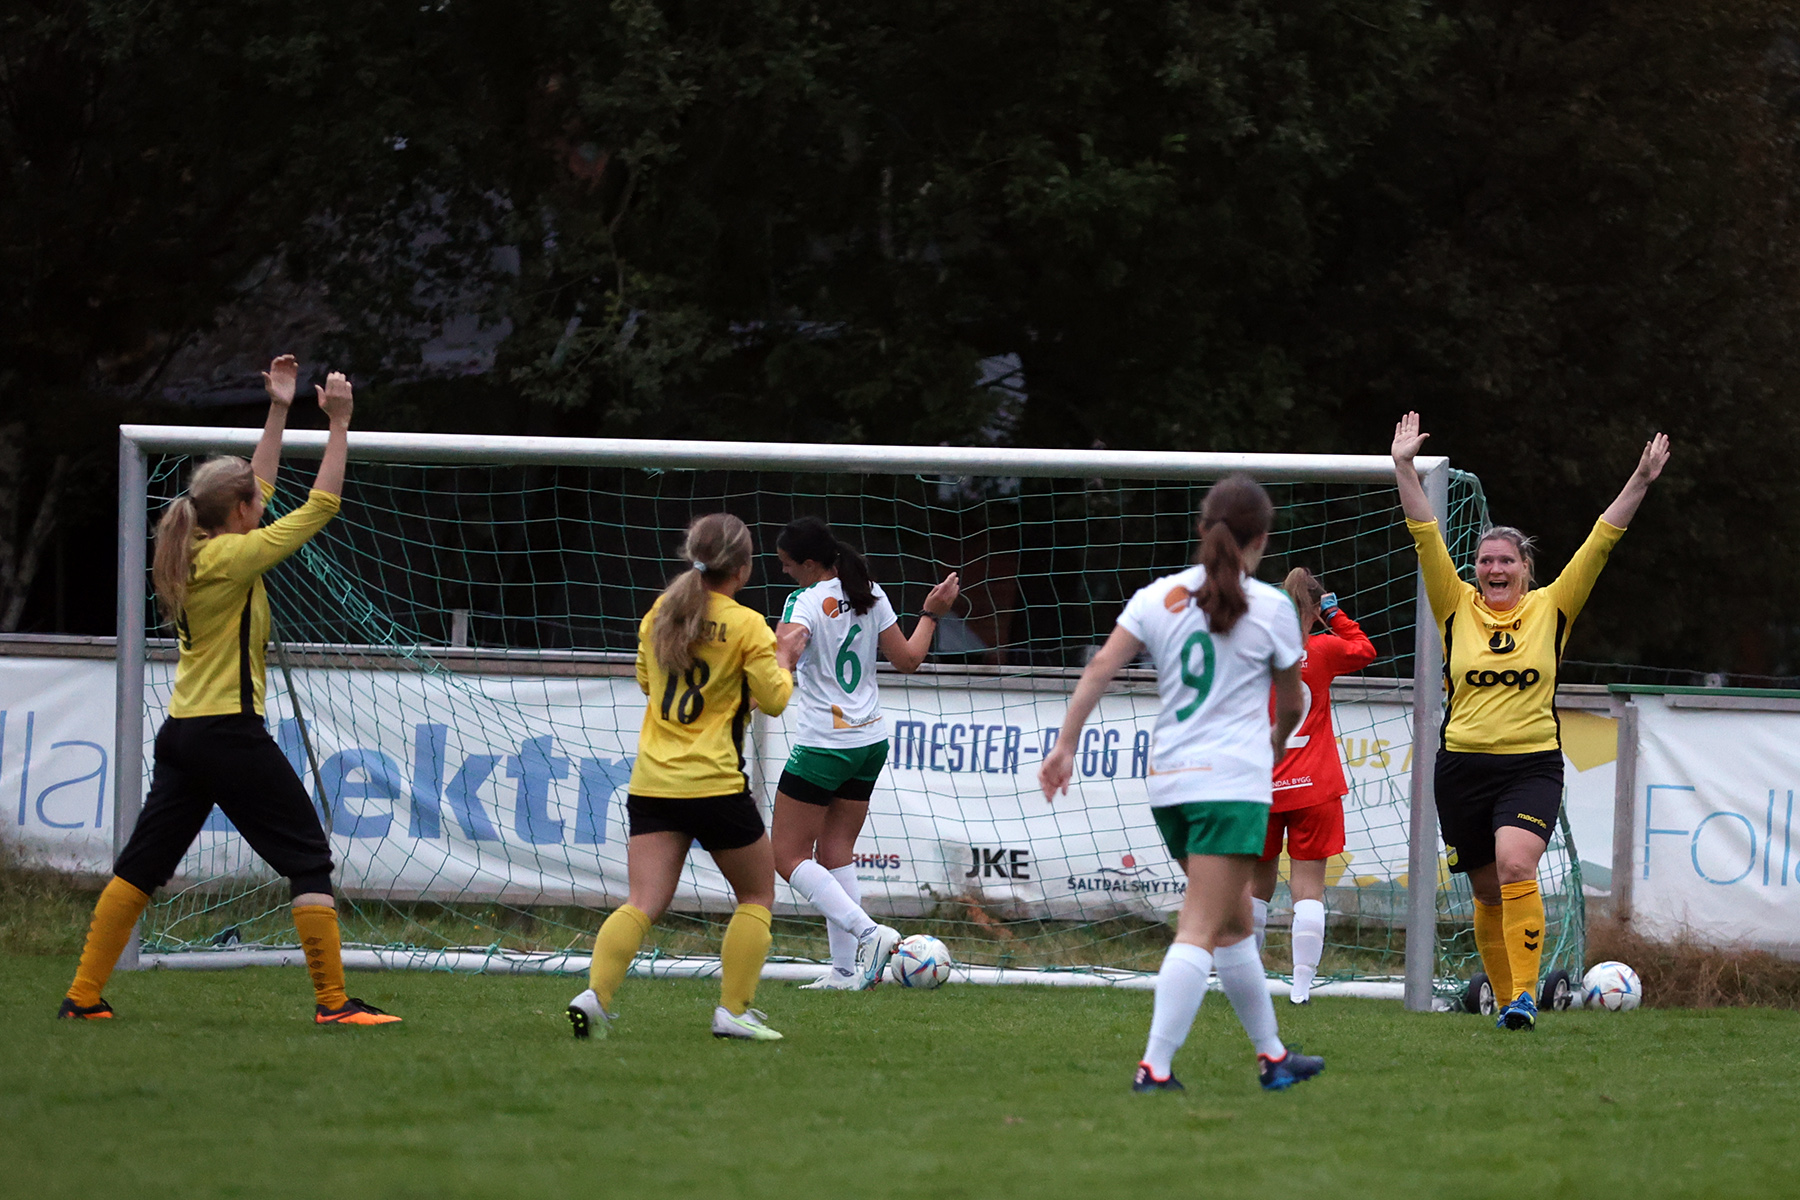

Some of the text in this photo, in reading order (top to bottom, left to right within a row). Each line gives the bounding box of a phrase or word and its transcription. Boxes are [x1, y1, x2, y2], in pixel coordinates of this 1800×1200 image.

[835, 623, 862, 694] 6
[1175, 629, 1216, 723] 9
[1465, 668, 1540, 690] coop
[661, 657, 710, 725] 18
[893, 720, 1120, 778] MESTER-GG
[1291, 775, 1312, 785] BYGG
[965, 847, 1030, 880] JKE
[1643, 784, 1800, 886] Foll
